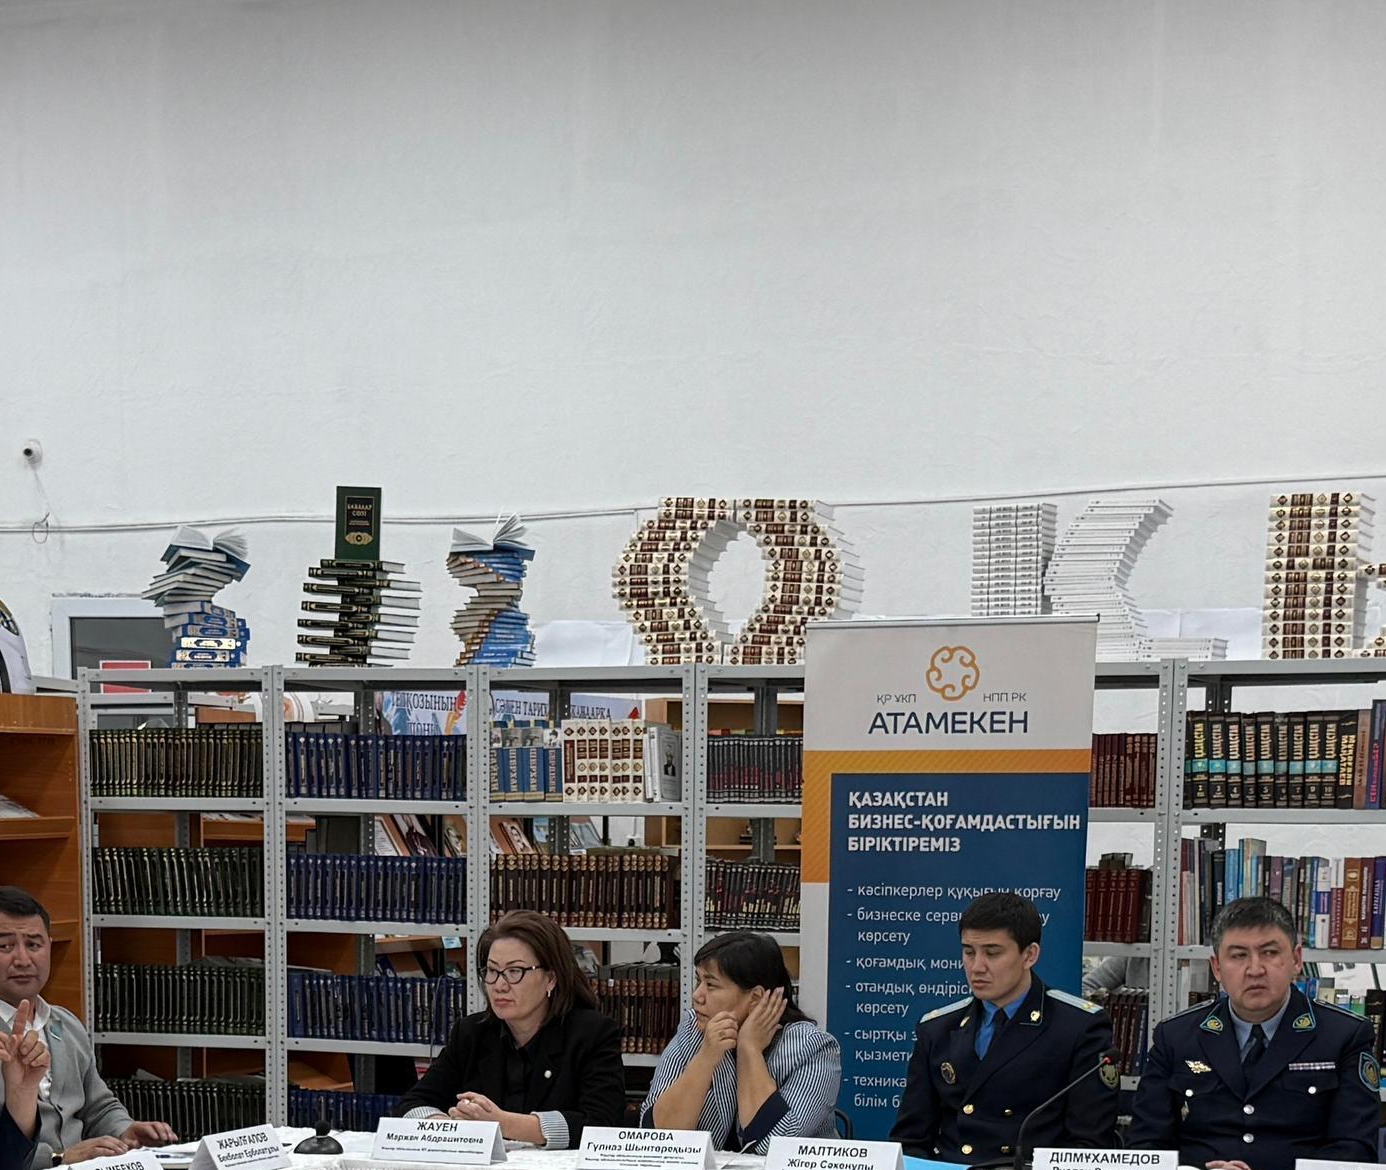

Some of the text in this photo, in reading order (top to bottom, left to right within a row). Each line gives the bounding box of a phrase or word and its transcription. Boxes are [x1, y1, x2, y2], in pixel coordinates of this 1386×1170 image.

[877, 694, 892, 706] ҚР
[983, 692, 1027, 702] НПП РК
[868, 711, 1029, 735] АТАМЕКЕН
[848, 791, 948, 808] ҚАЗАҚСТАН
[848, 813, 1081, 832] БИЗНЕС-ҚОҒАМДАСТЫҒЫН
[847, 836, 961, 852] БІРІКТІРЕМІЗ
[857, 882, 943, 900] кәсіпкерлер
[857, 907, 921, 923] бизнеске
[858, 929, 911, 945] көрсету
[856, 957, 926, 971] қоғамдық
[855, 982, 915, 996] отандық
[856, 1003, 909, 1017] көрсету
[854, 1029, 907, 1043] сыртқы
[854, 1093, 888, 1108] білім
[417, 1121, 458, 1132] ЖАУЕН
[618, 1131, 674, 1141] ОМАРОВА
[798, 1145, 868, 1158] МАЛТИКОВ
[1049, 1152, 1160, 1165] ДІЛМҰХАМЕДОВ
